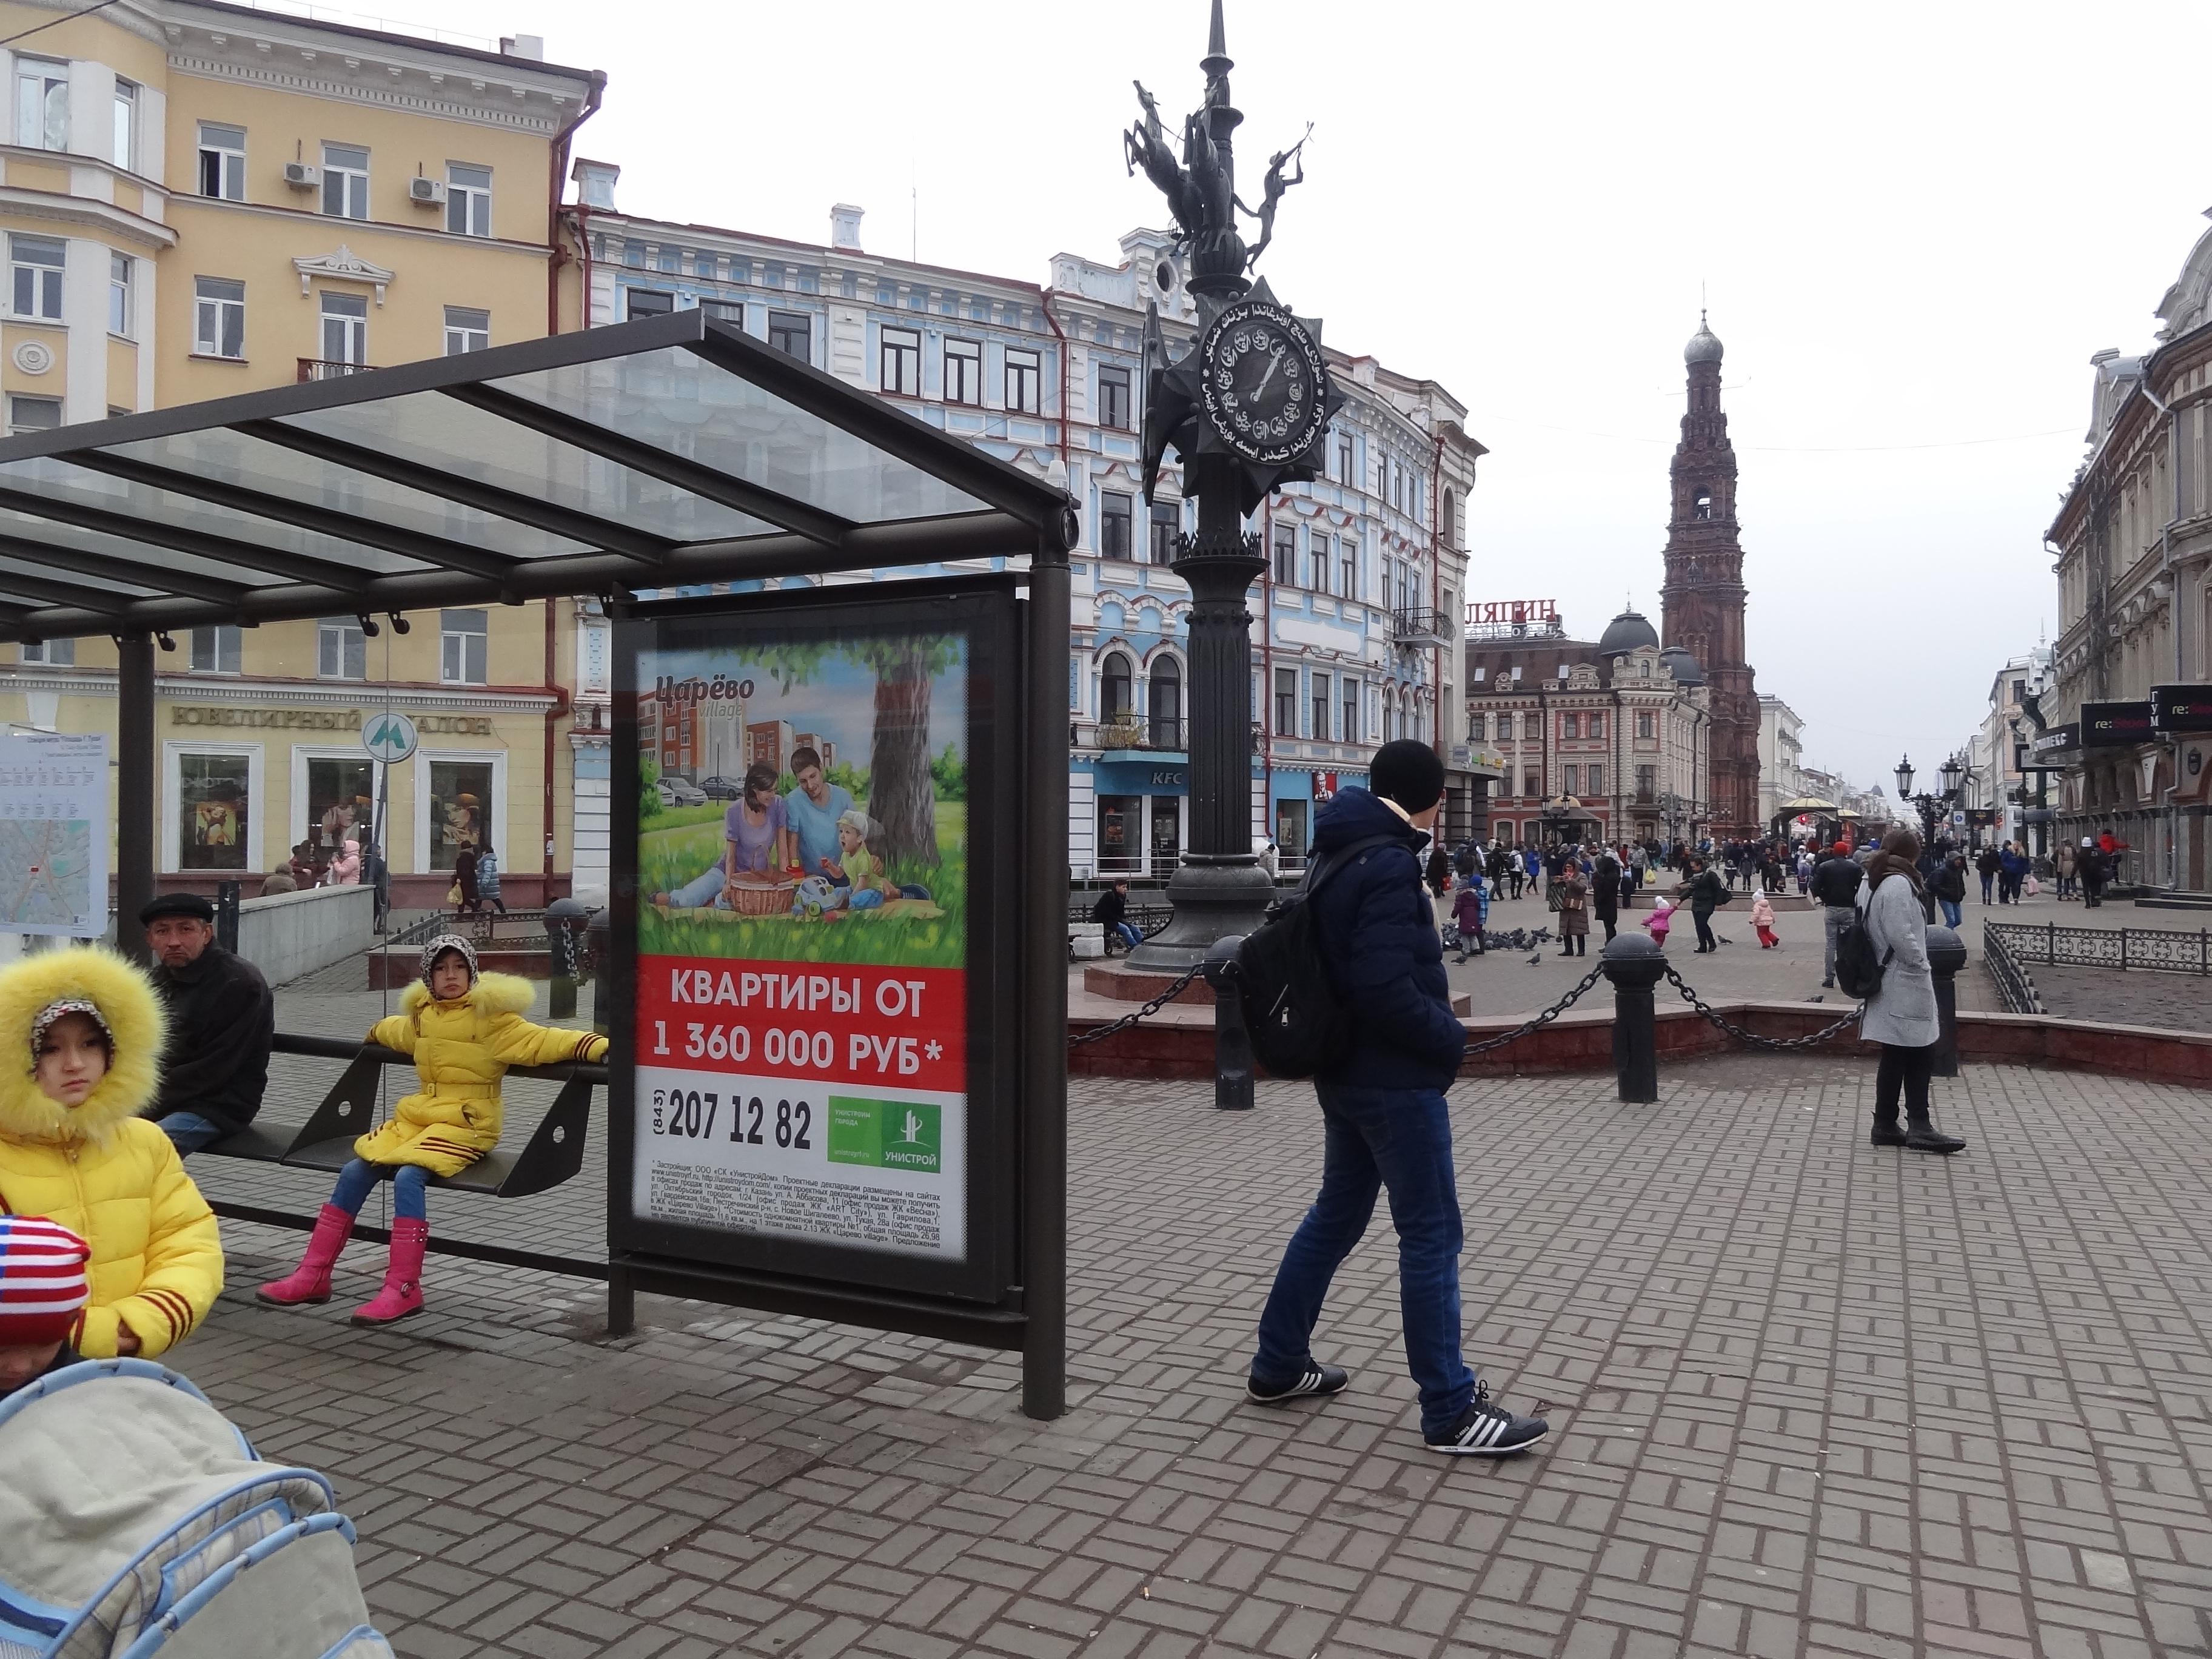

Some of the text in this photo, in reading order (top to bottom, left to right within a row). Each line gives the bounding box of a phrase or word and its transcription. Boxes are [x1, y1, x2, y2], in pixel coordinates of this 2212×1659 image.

[655, 674, 754, 709] Царёво
[172, 706, 492, 734] ЮВЕЛИРНЫЙ АЛОН
[699, 701, 743, 720] village
[2150, 691, 2159, 727] ГУМ
[1152, 772, 1182, 785] KFC
[671, 969, 926, 1017] КВАРТИРЫ ОТ
[654, 1021, 670, 1055] 1
[685, 1022, 751, 1061] 360
[764, 1028, 834, 1068] 000
[653, 1089, 811, 1150] (843) 207 12 82
[885, 1151, 936, 1165] УНИСТРОЙ
[657, 1175, 678, 1185] офисах
[680, 1180, 702, 1188] продаж
[751, 1187, 773, 1196] Казань
[796, 1192, 828, 1204] Аббасова,
[842, 1198, 861, 1208] (офис
[864, 1202, 888, 1212] продаж
[891, 1204, 902, 1212] ЖК
[664, 1183, 702, 1196] Октябрьский
[757, 1195, 776, 1205] (офис
[780, 1199, 805, 1208] продаж
[695, 1165, 711, 1173] ООО
[783, 1175, 818, 1187] Проектные
[820, 1181, 860, 1192] декларации
[863, 1186, 902, 1197] размещены
[917, 1191, 940, 1201] сайтах
[794, 1185, 828, 1196] проектных
[829, 1189, 868, 1201] деклараций
[882, 1196, 906, 1205] можете
[908, 1199, 940, 1210] получить
[764, 1212, 813, 1225] однокомнатной
[815, 1219, 845, 1230] квартиры
[863, 1224, 885, 1234] общая
[888, 1228, 919, 1239] площадь
[782, 1206, 801, 1215] Новое
[803, 1208, 840, 1221] Шигалеево,
[892, 1219, 912, 1231] (офис
[914, 1224, 940, 1235] продаж
[833, 1227, 861, 1239] «Царево
[893, 1235, 940, 1249] Предложение
